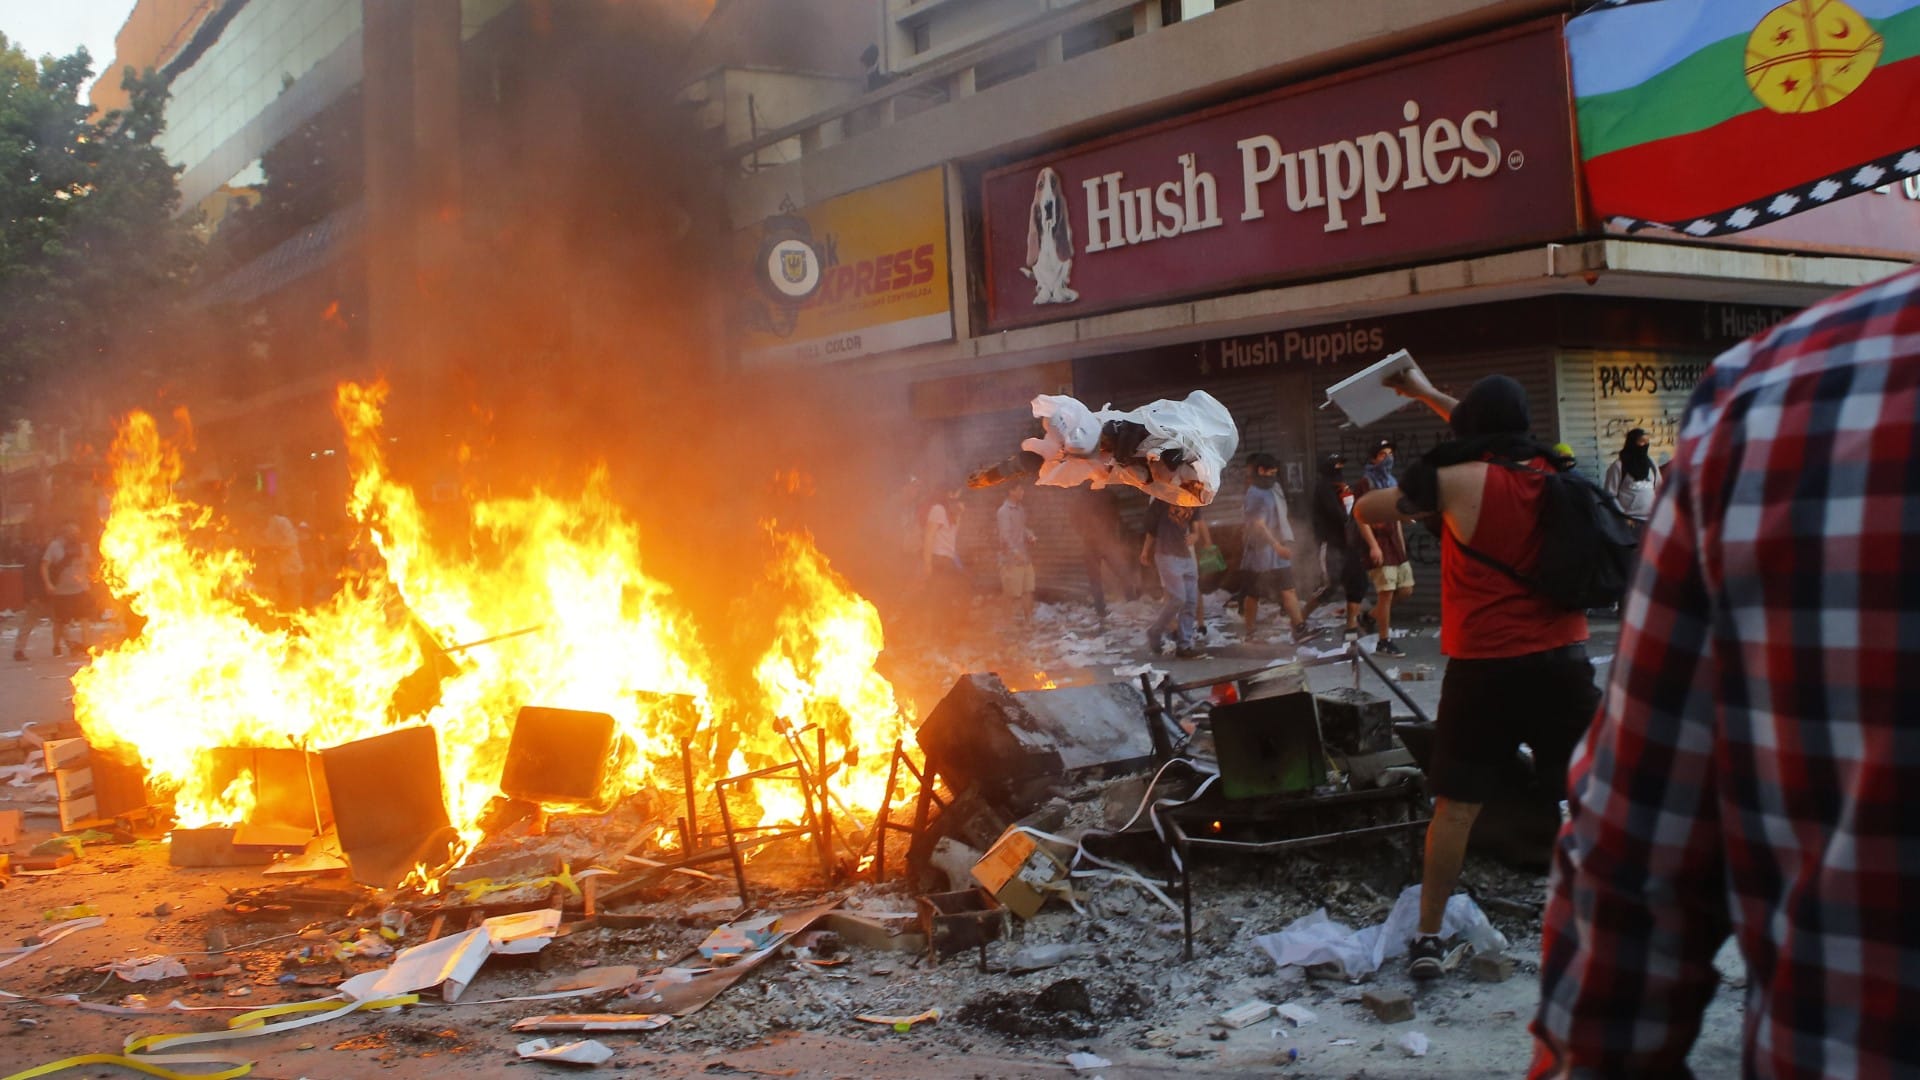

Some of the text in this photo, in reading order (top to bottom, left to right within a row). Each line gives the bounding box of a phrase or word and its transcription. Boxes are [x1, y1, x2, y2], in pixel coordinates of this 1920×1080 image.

[1082, 153, 1223, 252] Hush
[1237, 100, 1501, 233] Puppies
[803, 244, 934, 309] XPRESS
[1721, 306, 1767, 337] Hush
[825, 336, 862, 355] COLOR
[1221, 324, 1384, 368] Hush Puppies
[1600, 363, 1657, 398] PACOS
